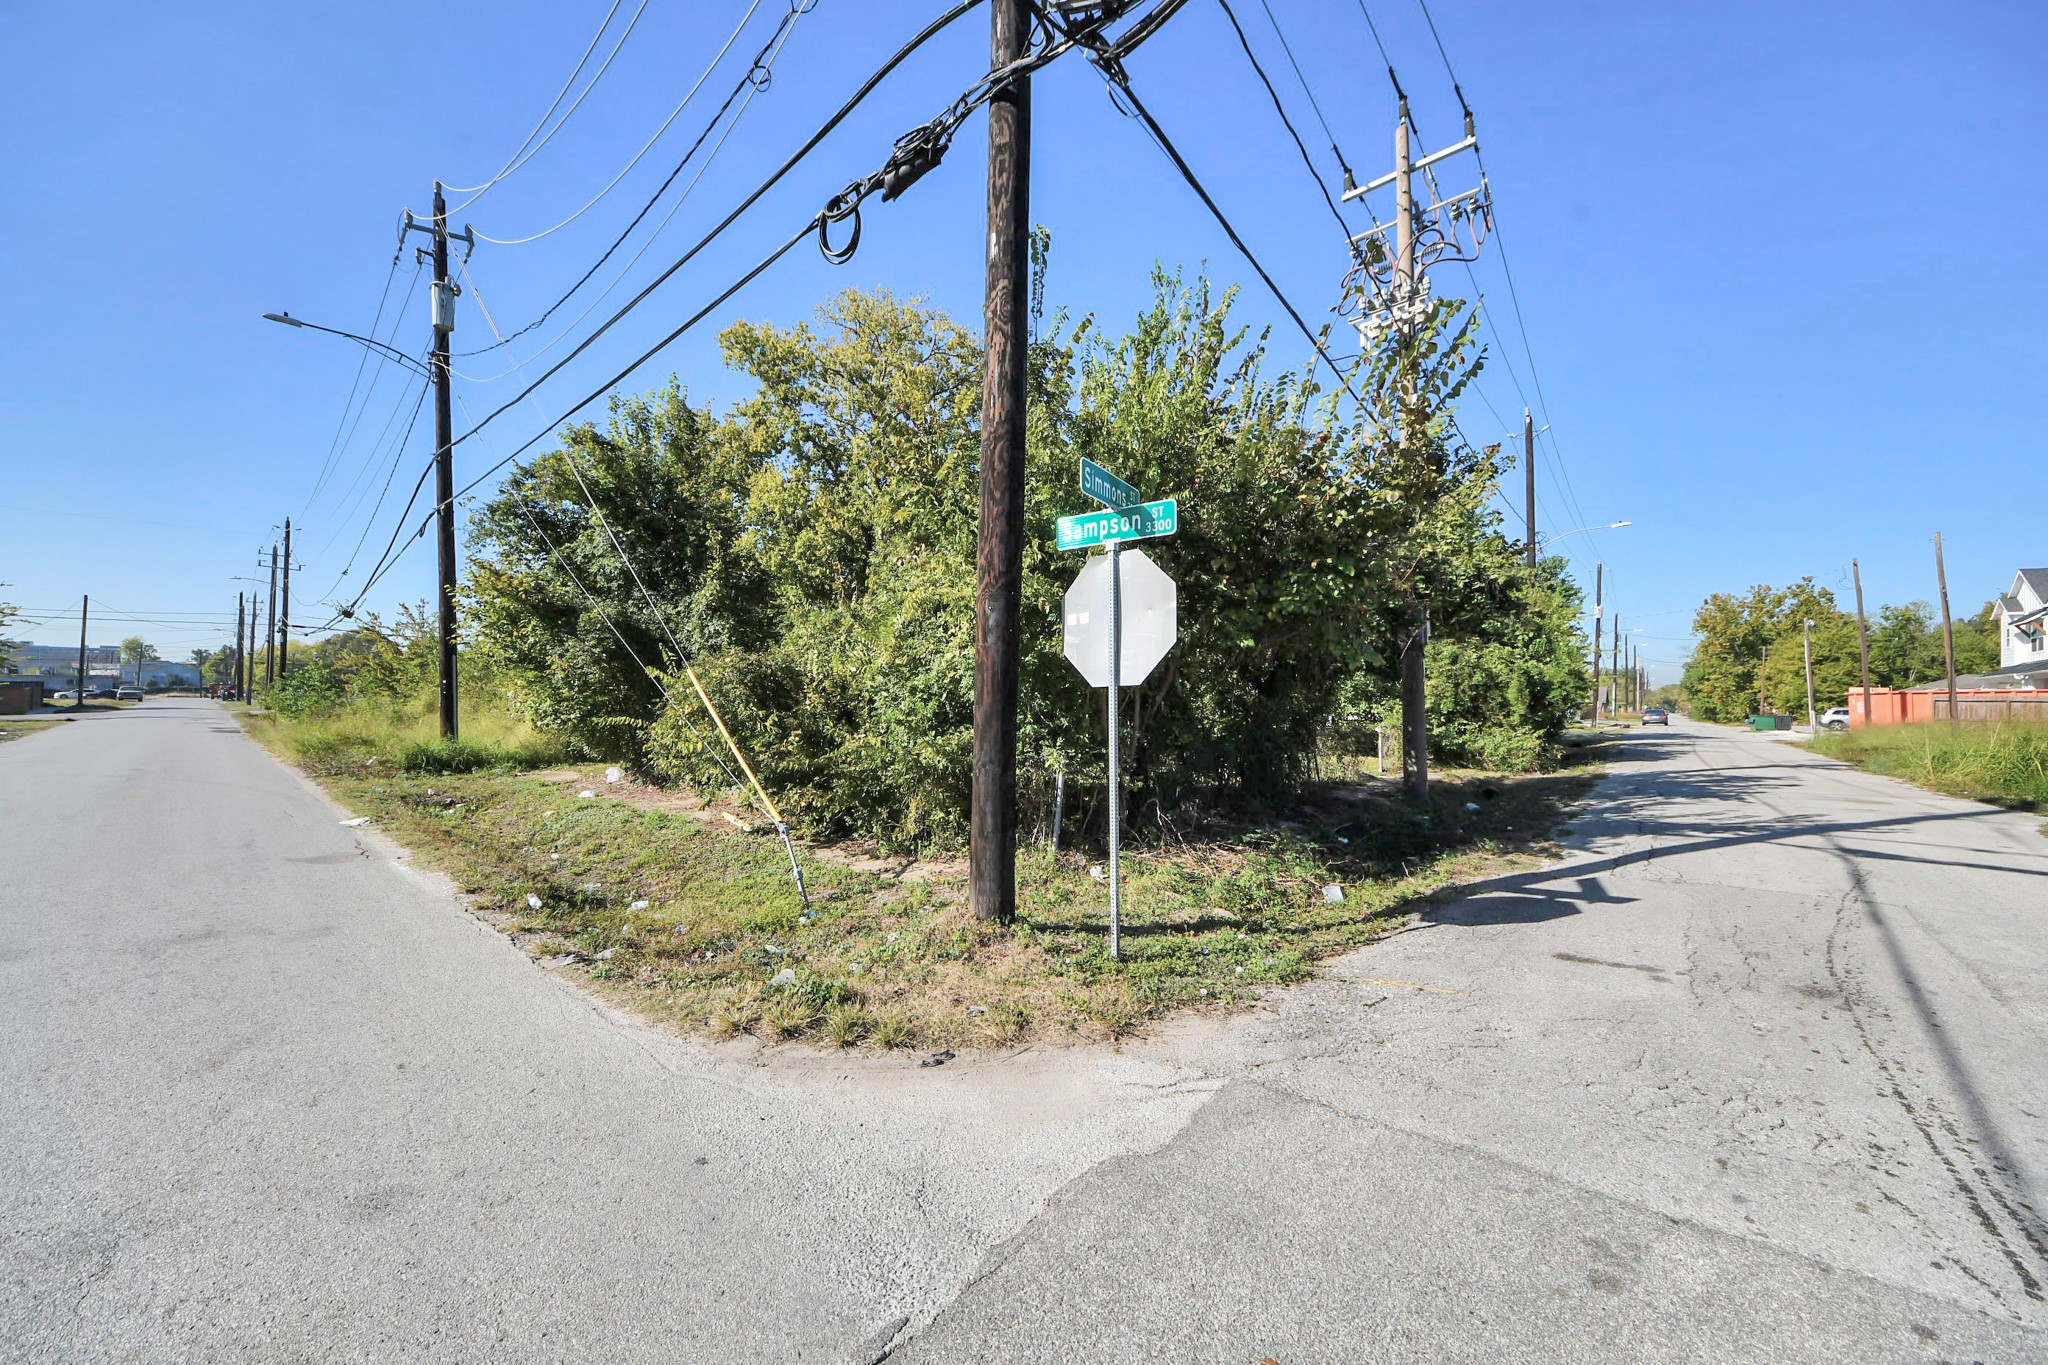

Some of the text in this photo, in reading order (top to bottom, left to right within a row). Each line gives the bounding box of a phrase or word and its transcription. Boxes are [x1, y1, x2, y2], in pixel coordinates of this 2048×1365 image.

[1084, 466, 1127, 507] Simmons
[1061, 505, 1165, 541] Sampson ST
[1145, 518, 1172, 533] 3300
